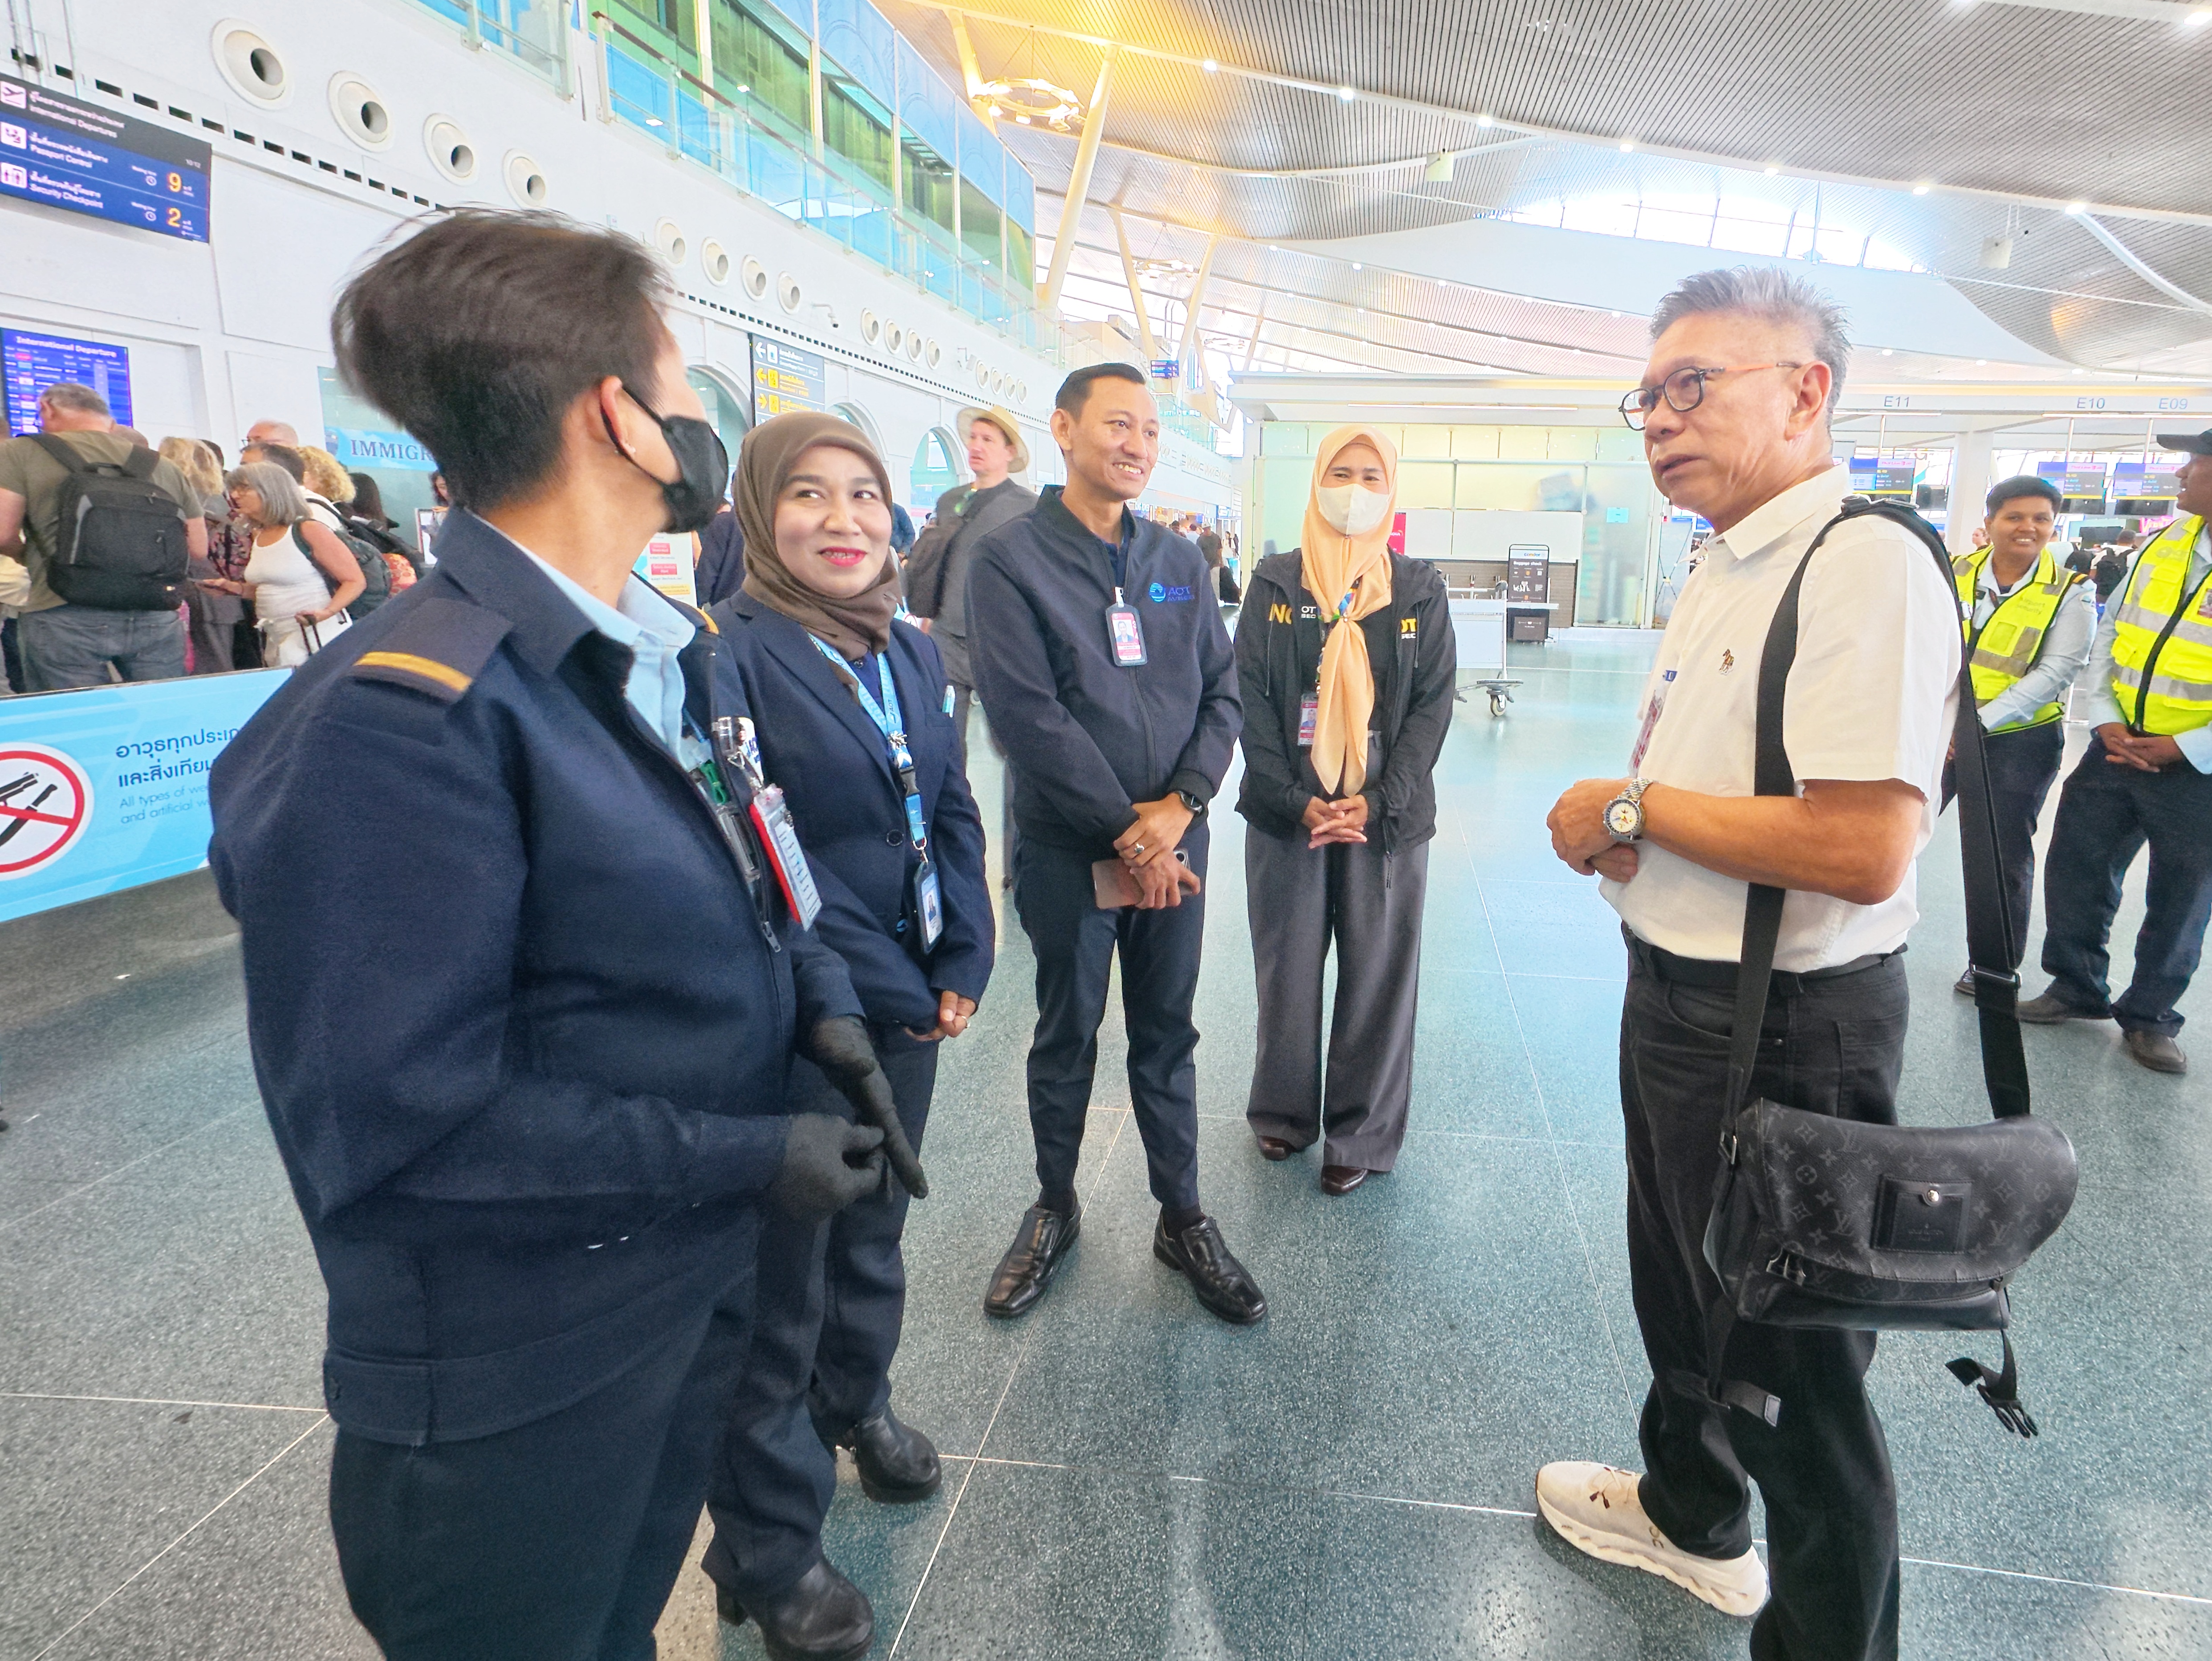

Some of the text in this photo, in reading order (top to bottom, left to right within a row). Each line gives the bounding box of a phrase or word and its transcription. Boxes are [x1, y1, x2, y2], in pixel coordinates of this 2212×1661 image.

[167, 172, 182, 193] 9
[167, 208, 182, 228] 2
[1884, 396, 1909, 407] E11
[2077, 397, 2106, 409] E10
[2159, 398, 2188, 409] E09
[1168, 586, 1190, 596] AOT
[120, 795, 134, 809] All
[139, 791, 170, 807] types
[174, 785, 185, 798] of
[121, 809, 146, 824] and
[150, 799, 193, 818] artificial
